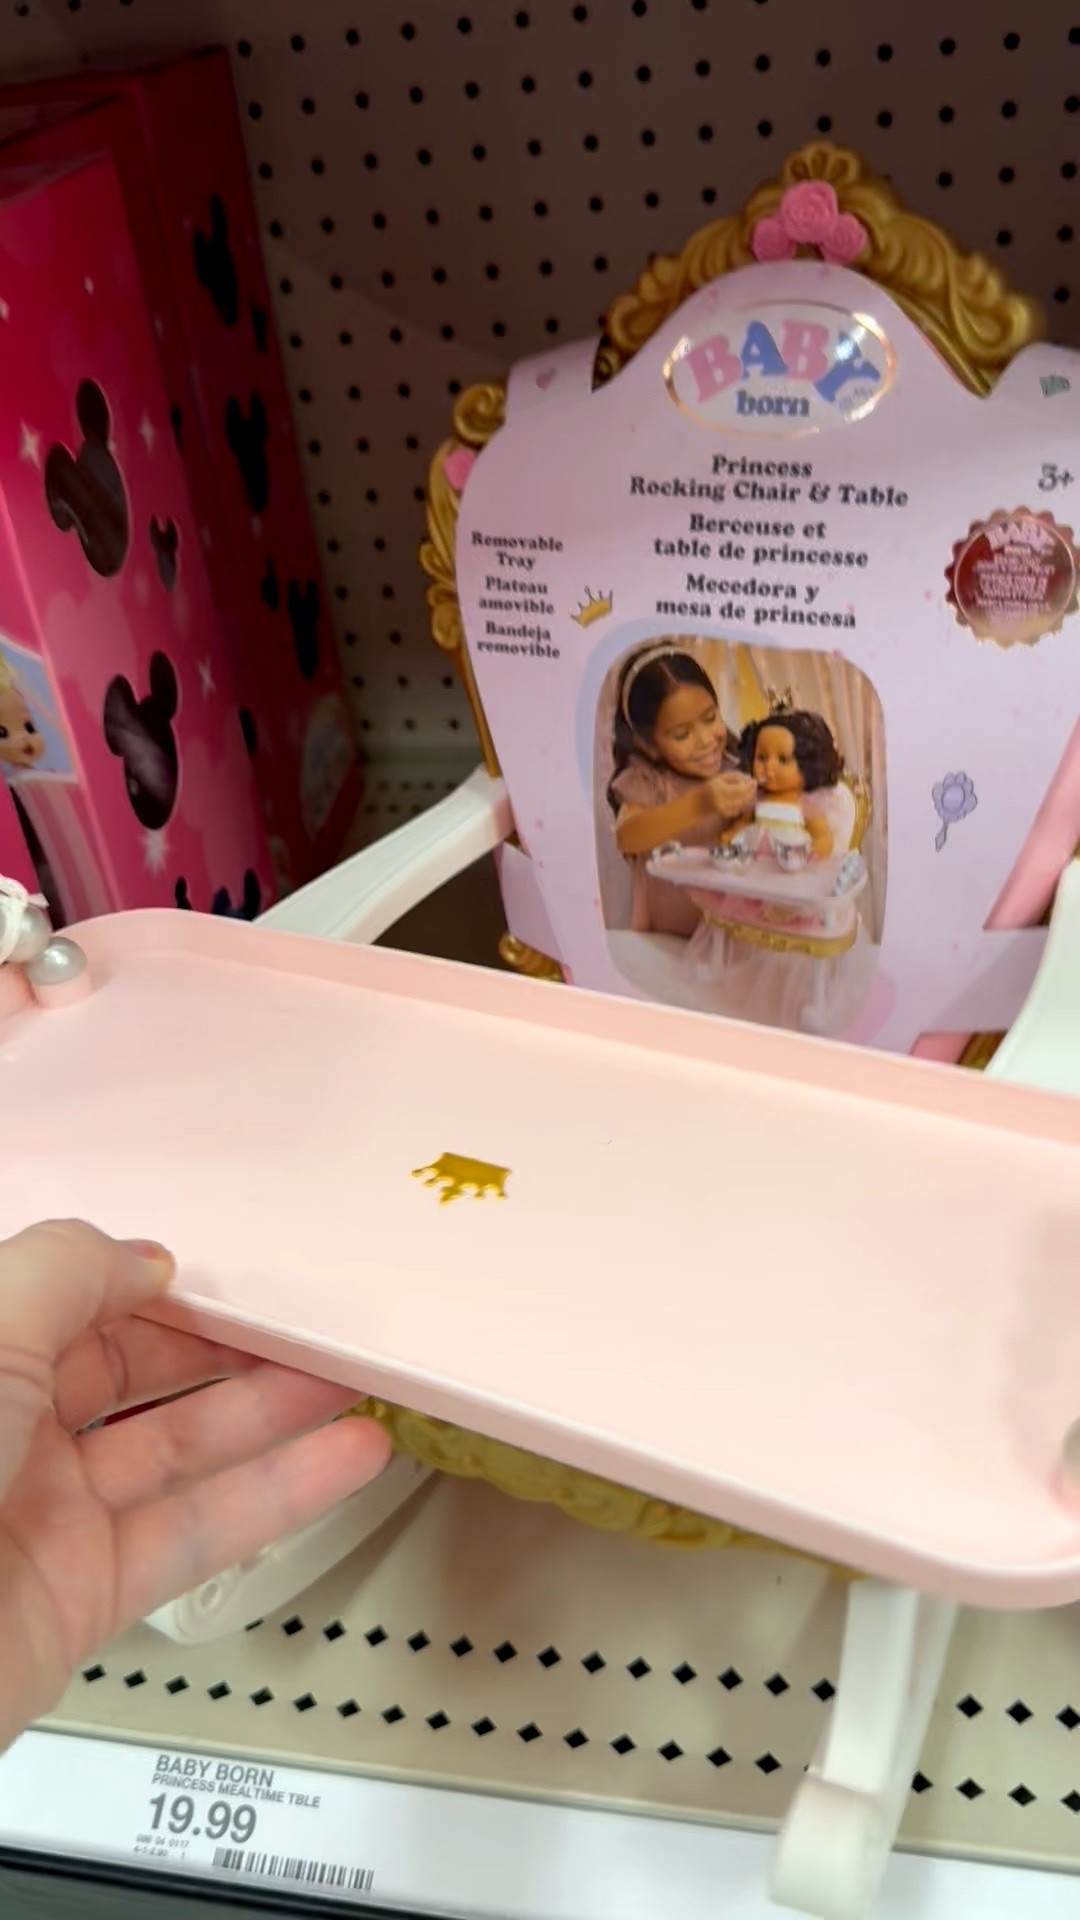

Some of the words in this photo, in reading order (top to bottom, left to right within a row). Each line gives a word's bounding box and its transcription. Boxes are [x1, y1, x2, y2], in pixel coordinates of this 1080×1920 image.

[685, 319, 881, 403] BABY
[736, 389, 810, 417] born
[712, 454, 812, 478] Princess
[1038, 463, 1074, 491] 3+
[630, 476, 725, 502] Rocking
[733, 481, 801, 502] Chair
[808, 483, 831, 503] &
[838, 484, 909, 507] Table
[689, 514, 795, 537] Berceuse
[803, 521, 826, 538] et
[471, 531, 564, 551] Removable
[654, 538, 711, 558] table
[719, 542, 745, 559] de
[753, 544, 868, 567] princesse
[497, 551, 535, 571] Tray
[486, 576, 548, 595] Plateau
[686, 573, 797, 600] Mecedora
[805, 585, 819, 604] y
[479, 598, 555, 615] amovible
[656, 599, 711, 617] mesa
[720, 602, 746, 619] de
[754, 604, 856, 628] princesa
[485, 620, 551, 642] Bandeja
[477, 641, 561, 659] removible
[155, 1755, 211, 1778] BABY
[216, 1763, 275, 1787] BORN
[151, 1773, 215, 1793] PRINCESS
[218, 1782, 285, 1803] MEALTIME
[289, 1792, 321, 1809] TBLE
[149, 1793, 257, 1844] 19.99
